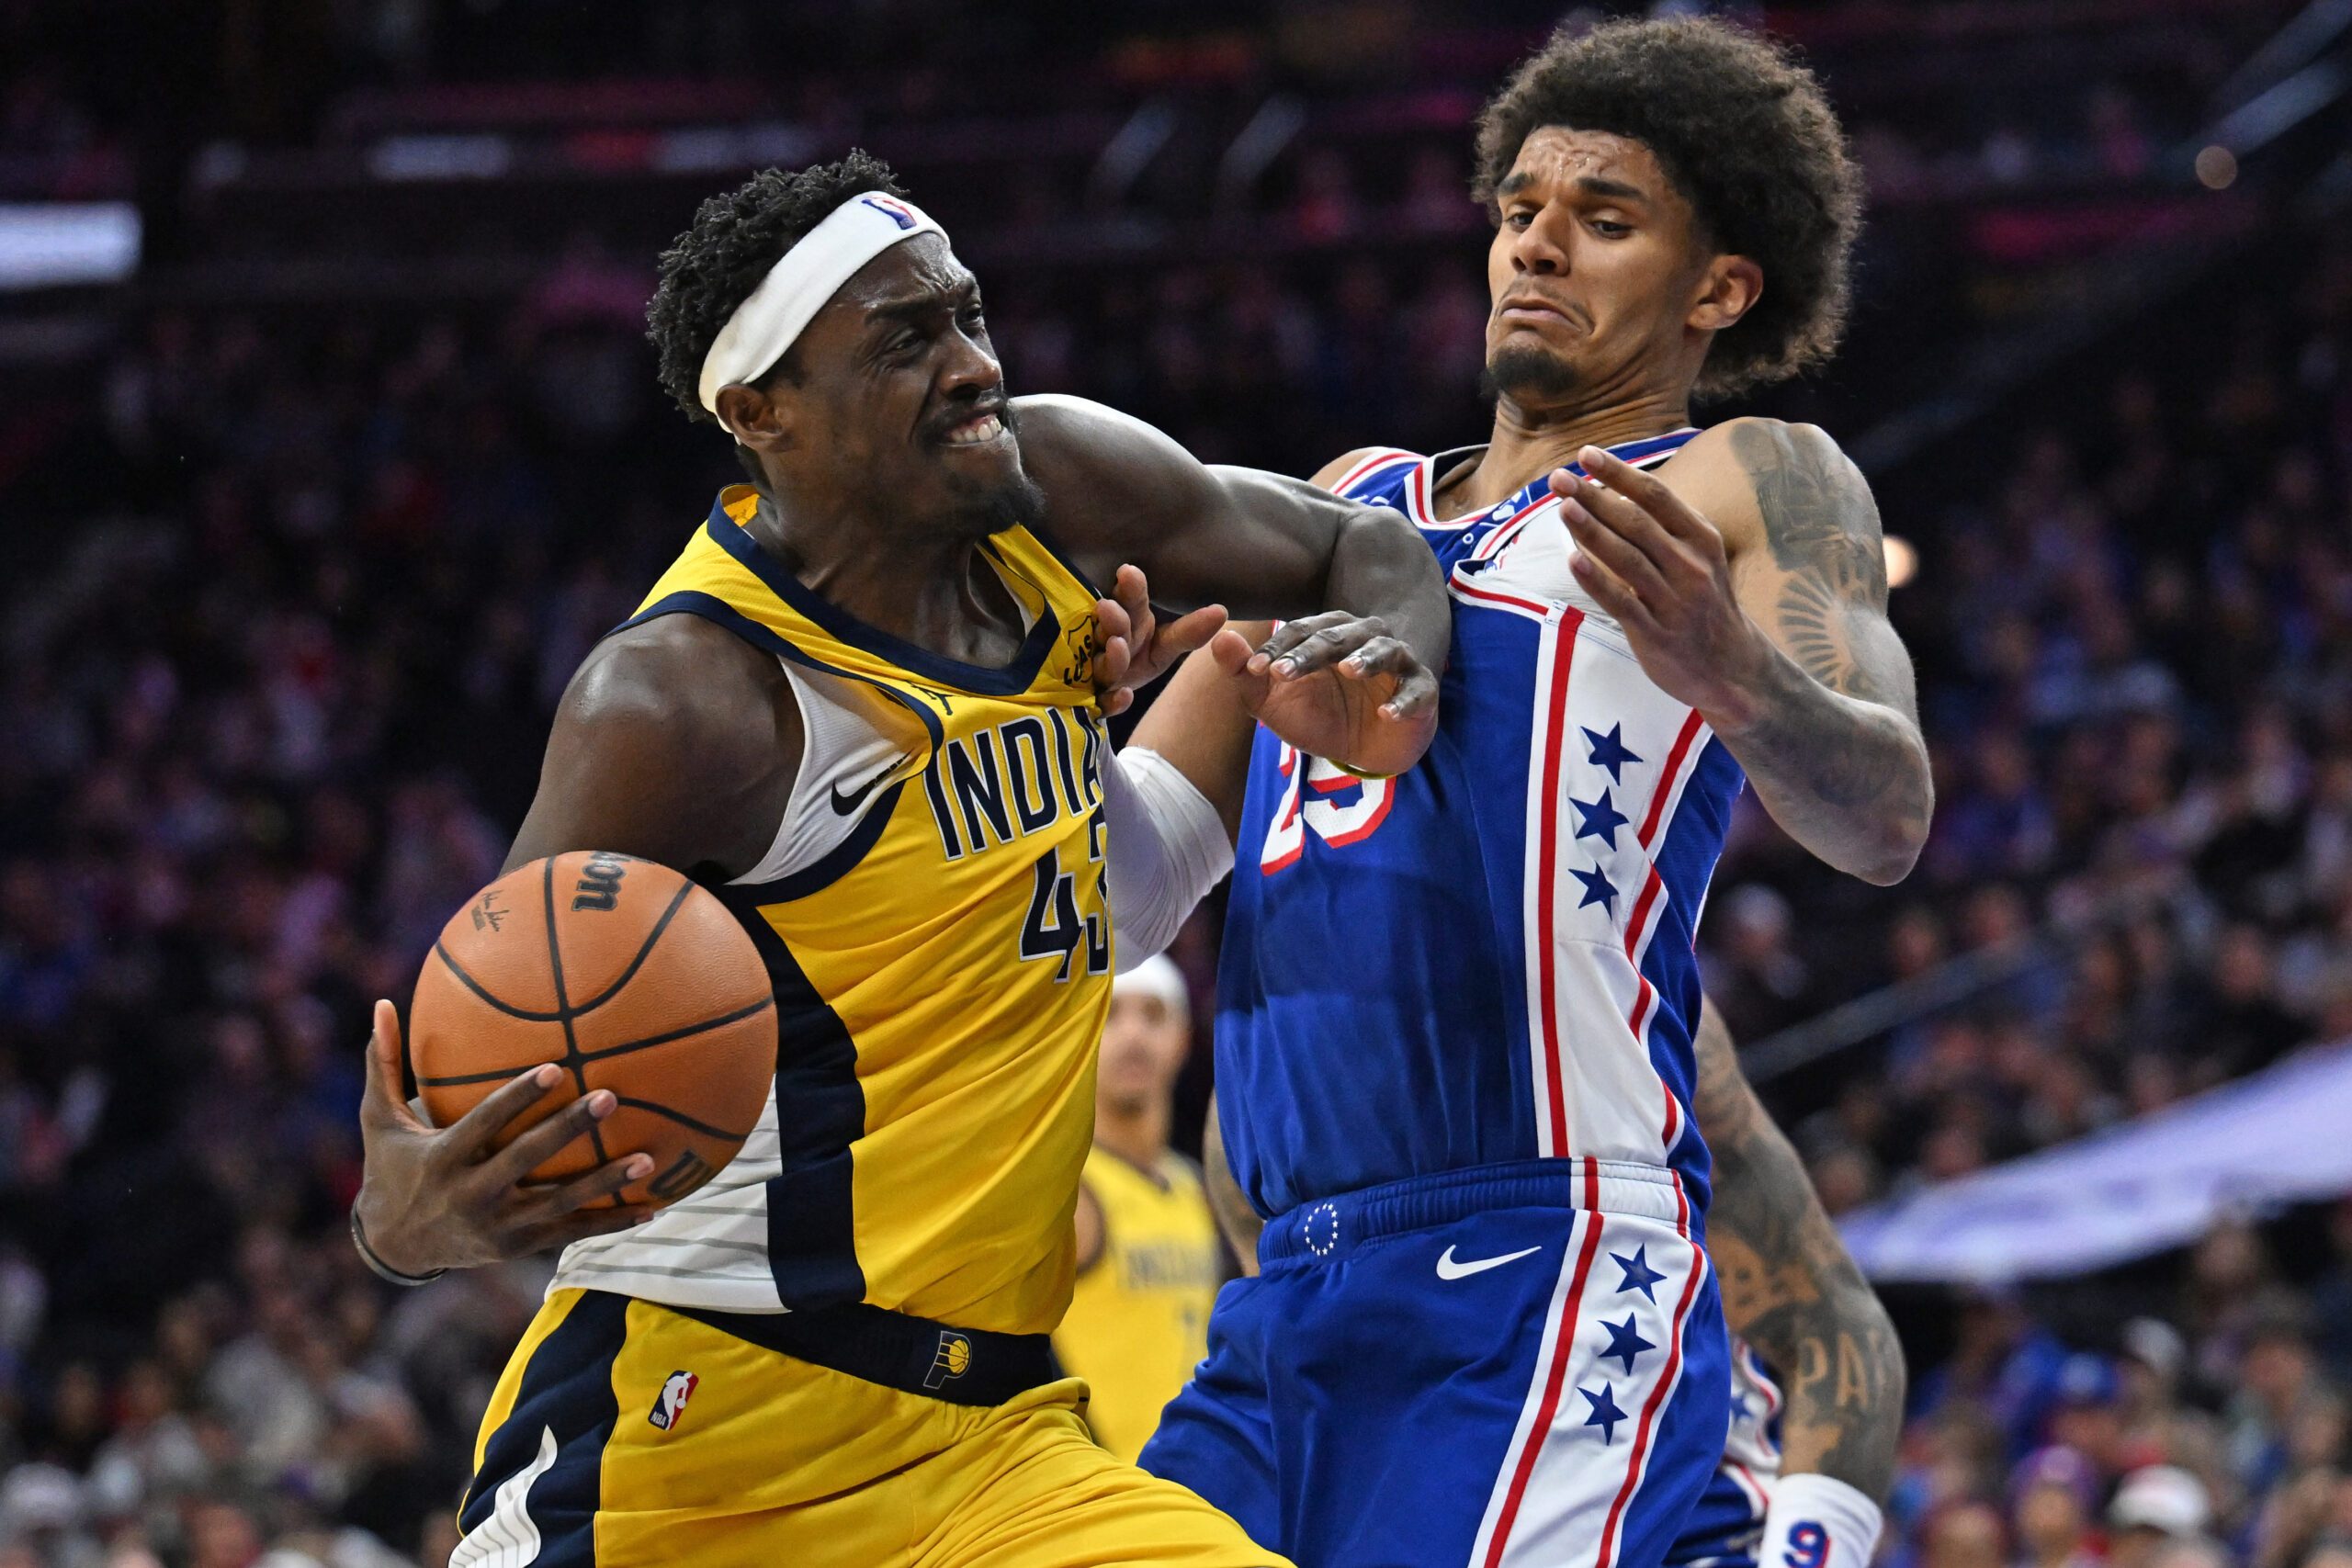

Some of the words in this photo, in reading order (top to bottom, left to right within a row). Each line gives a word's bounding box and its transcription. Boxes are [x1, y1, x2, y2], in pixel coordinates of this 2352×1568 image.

[922, 705, 1105, 862] INDIA
[651, 1411, 667, 1427] NBA
[1783, 1521, 1831, 1568] 9
